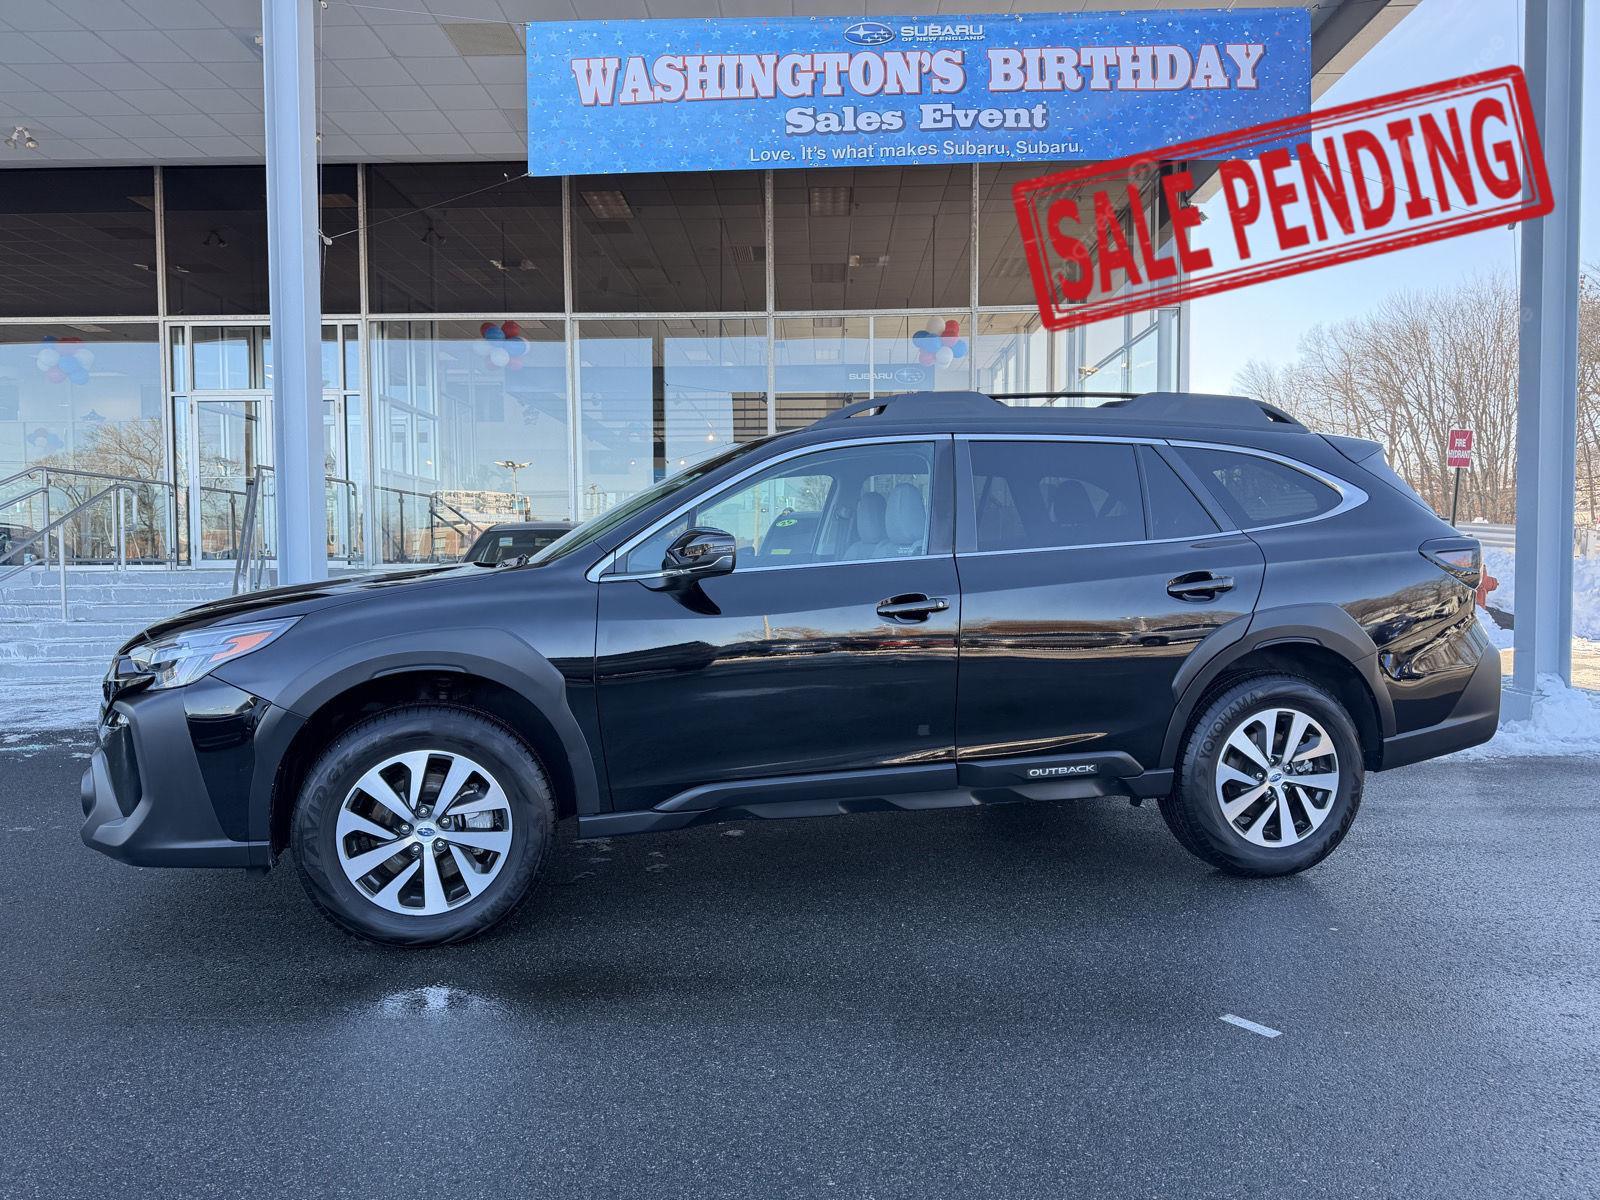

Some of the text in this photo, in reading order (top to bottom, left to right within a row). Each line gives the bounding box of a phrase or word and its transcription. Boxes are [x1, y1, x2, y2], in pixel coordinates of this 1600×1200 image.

[901, 25, 984, 36] SUBARU
[988, 44, 1265, 94] BIRTHDAY
[785, 102, 1048, 134] Sales Event
[750, 148, 796, 162] Love.
[832, 144, 874, 159] what
[880, 142, 938, 157] makes
[943, 140, 1012, 157] Subaru,
[1016, 139, 1084, 154] Subaru.
[848, 372, 893, 380] SUBARU
[1199, 692, 1258, 759] YOKOHAMA
[1029, 764, 1096, 777] OUTBACK
